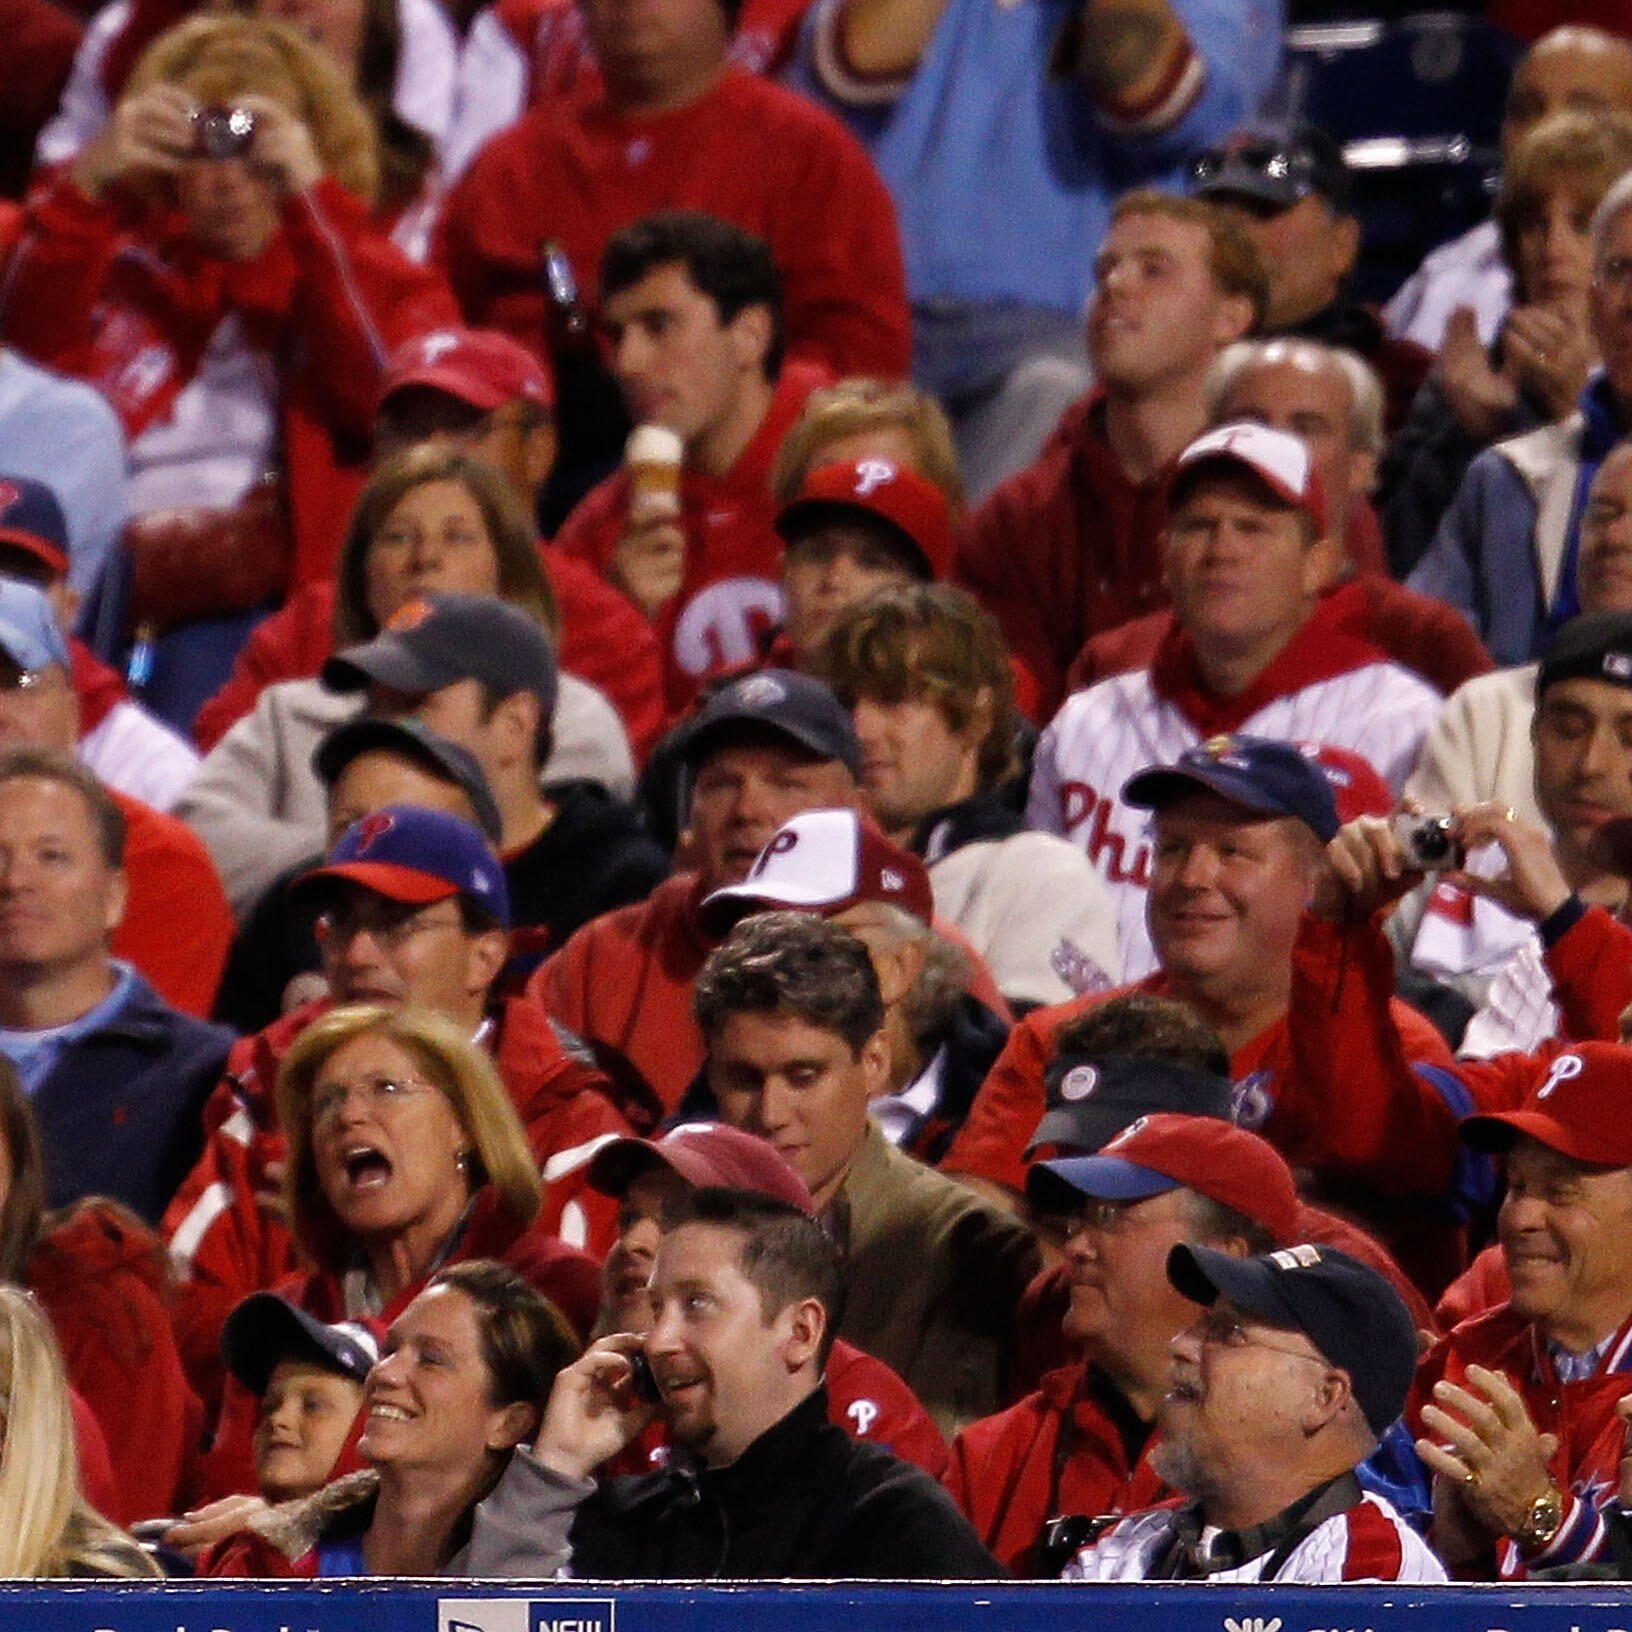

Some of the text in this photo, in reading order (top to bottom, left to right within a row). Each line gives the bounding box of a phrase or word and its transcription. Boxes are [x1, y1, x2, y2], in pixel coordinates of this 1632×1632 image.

[854, 457, 894, 498] P
[753, 831, 798, 877] P
[1536, 1054, 1583, 1100] P
[847, 1399, 878, 1435] P
